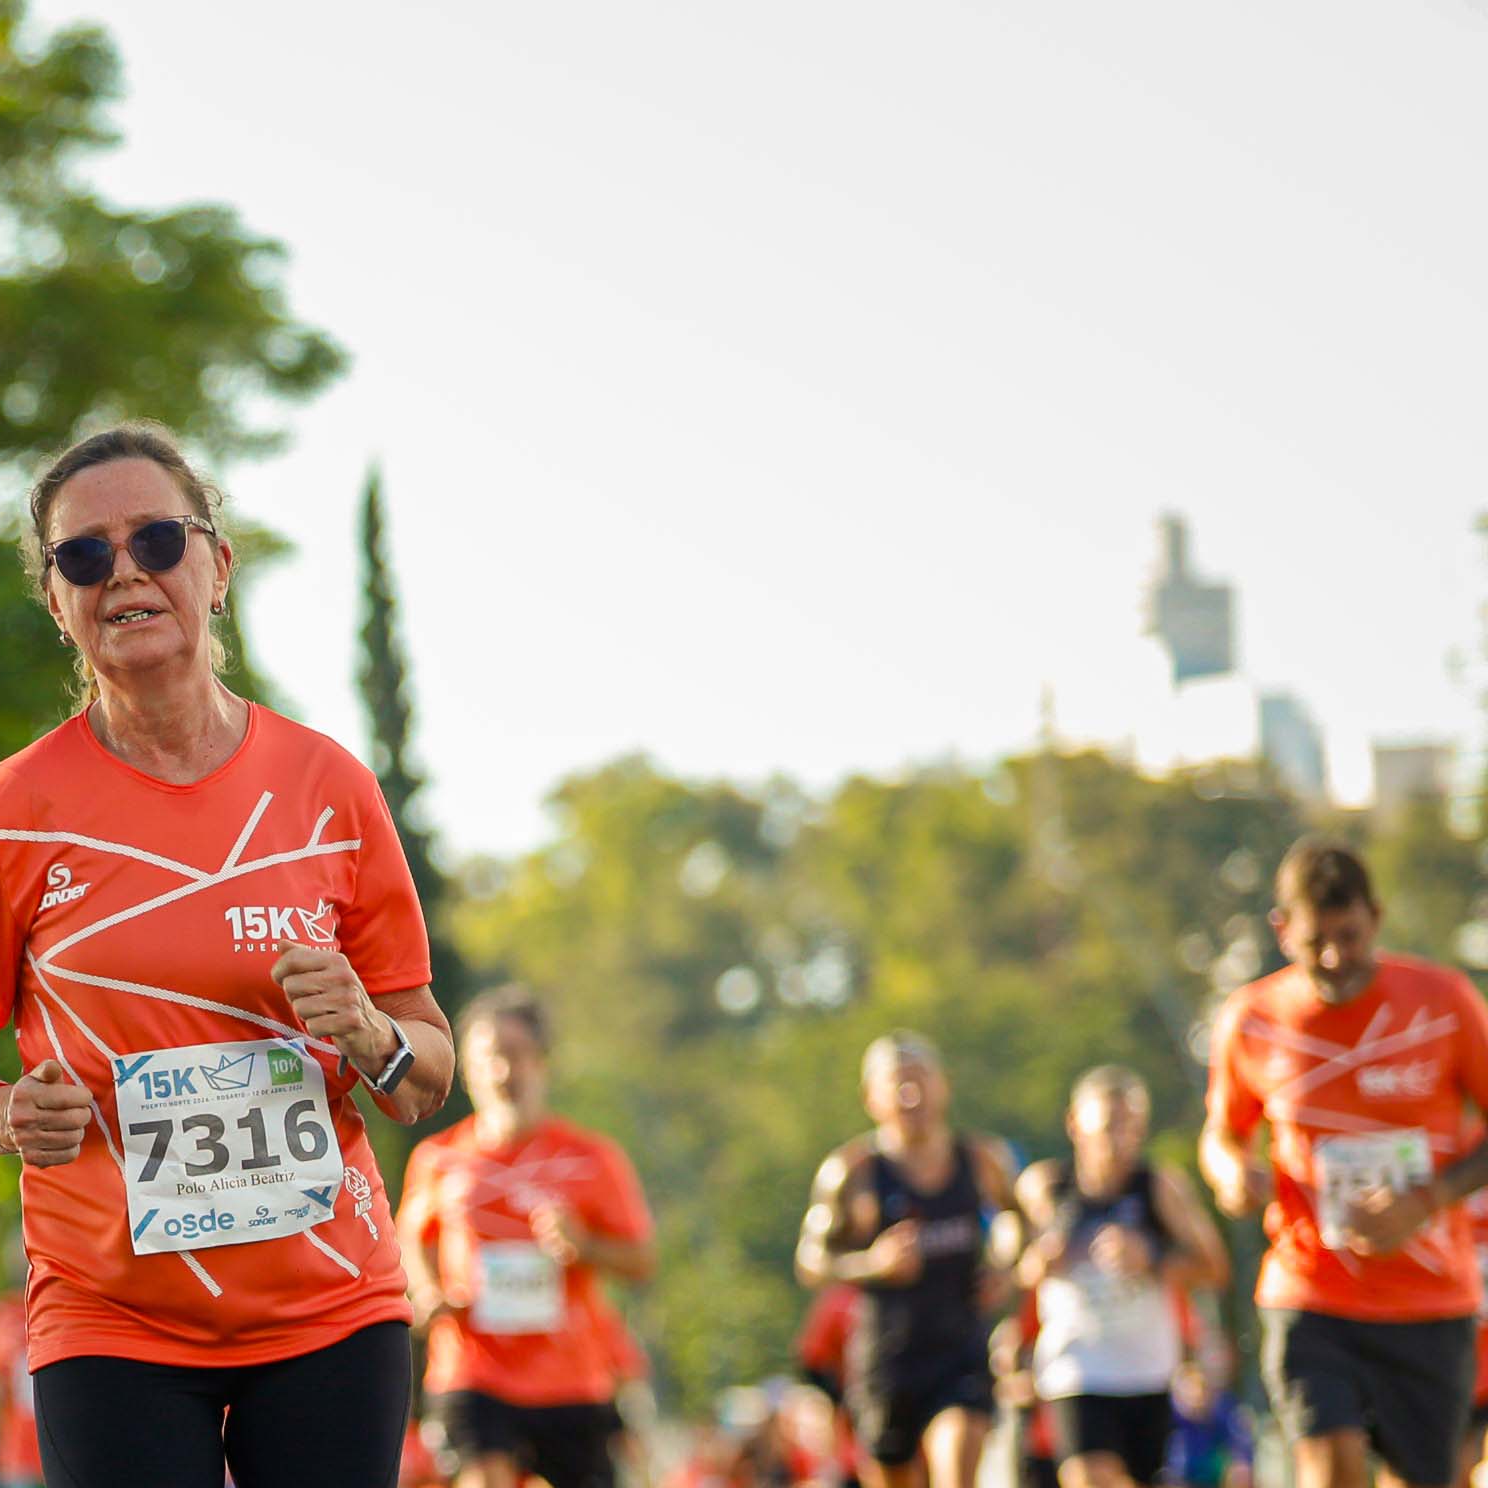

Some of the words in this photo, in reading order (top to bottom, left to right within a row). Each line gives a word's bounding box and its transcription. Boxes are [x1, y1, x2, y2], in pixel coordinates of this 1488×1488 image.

[224, 906, 299, 940] 15K
[271, 1056, 300, 1075] 10K
[138, 1066, 198, 1100] 15K
[128, 1099, 329, 1183] 7316
[176, 1183, 206, 1195] Polo
[210, 1177, 248, 1192] Alicia
[250, 1171, 296, 1186] Beatriz
[164, 1208, 235, 1238] osde
